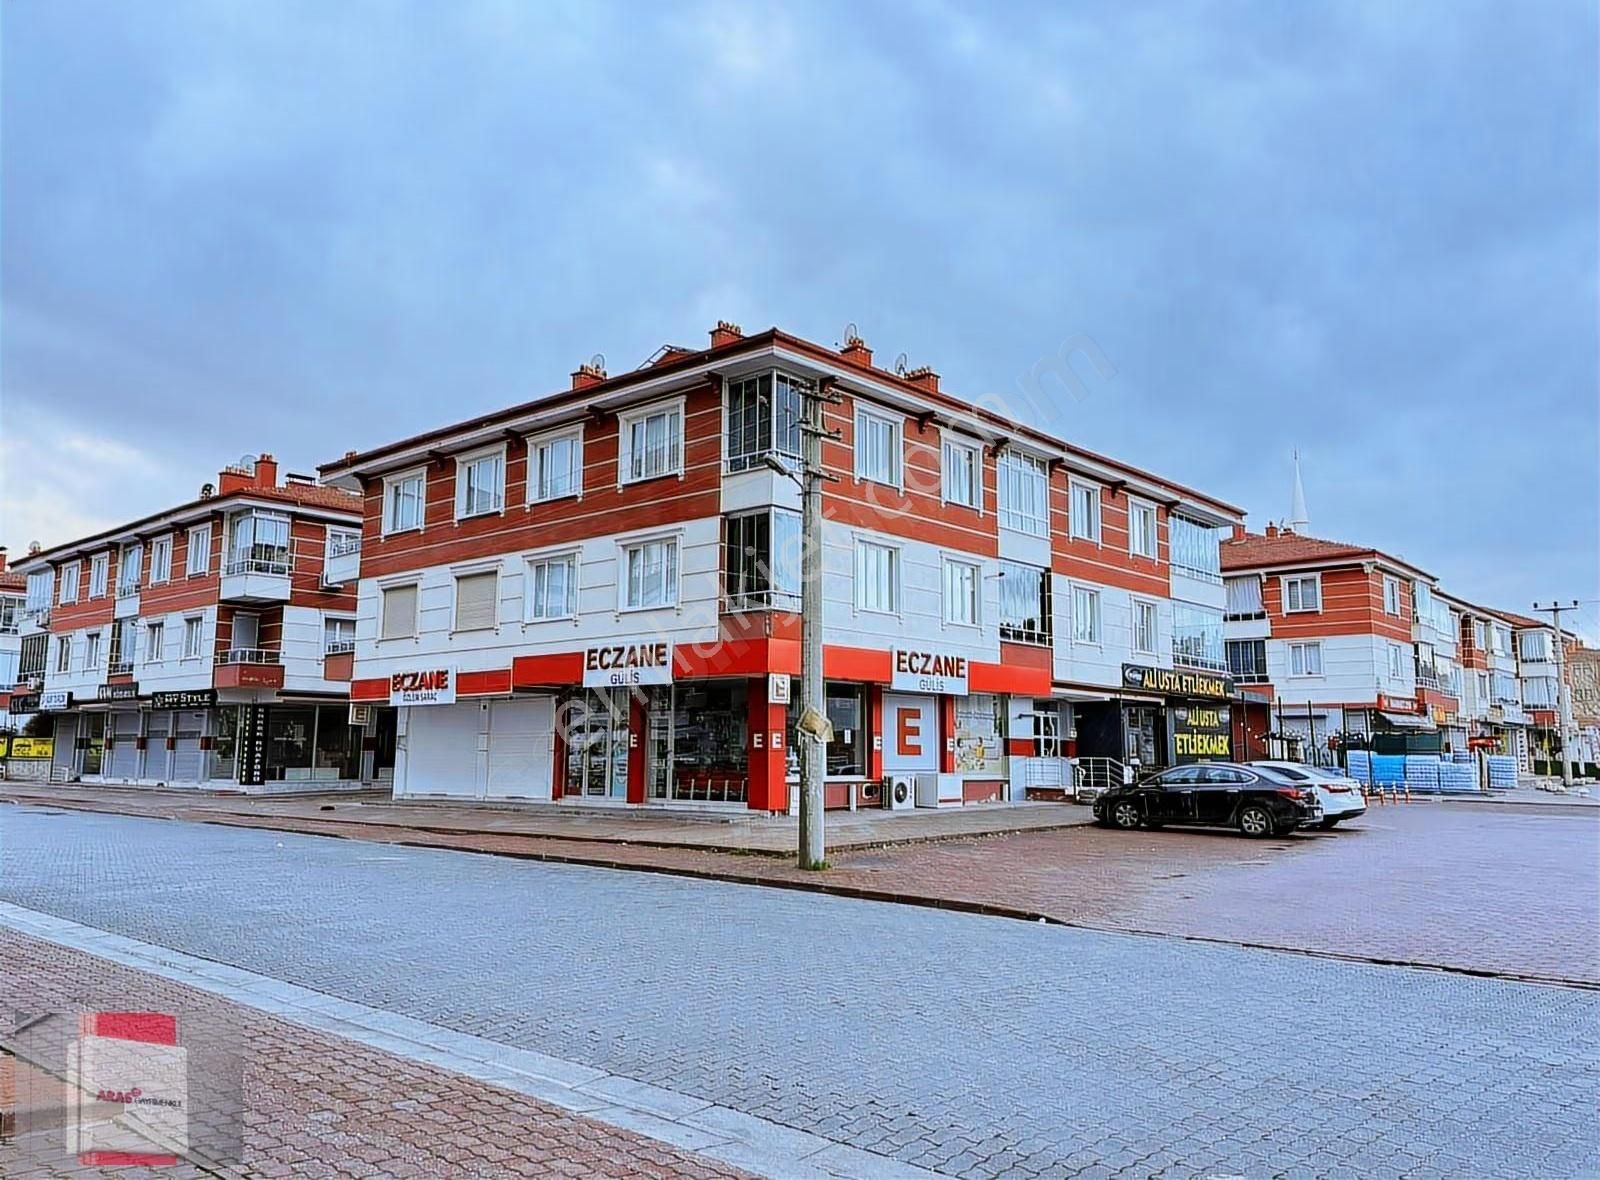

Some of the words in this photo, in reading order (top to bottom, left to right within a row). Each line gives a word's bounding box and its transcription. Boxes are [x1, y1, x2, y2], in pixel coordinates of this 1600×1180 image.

[586, 644, 667, 670] ECZANE
[896, 650, 966, 678] ECZANE
[392, 670, 449, 692] ECZANE
[1158, 670, 1181, 693] USTA
[1199, 709, 1220, 727] USTA
[754, 733, 763, 748] E
[772, 733, 782, 748] E
[897, 707, 922, 756] E
[630, 734, 638, 748] E
[874, 736, 882, 750] E
[947, 737, 955, 751] E
